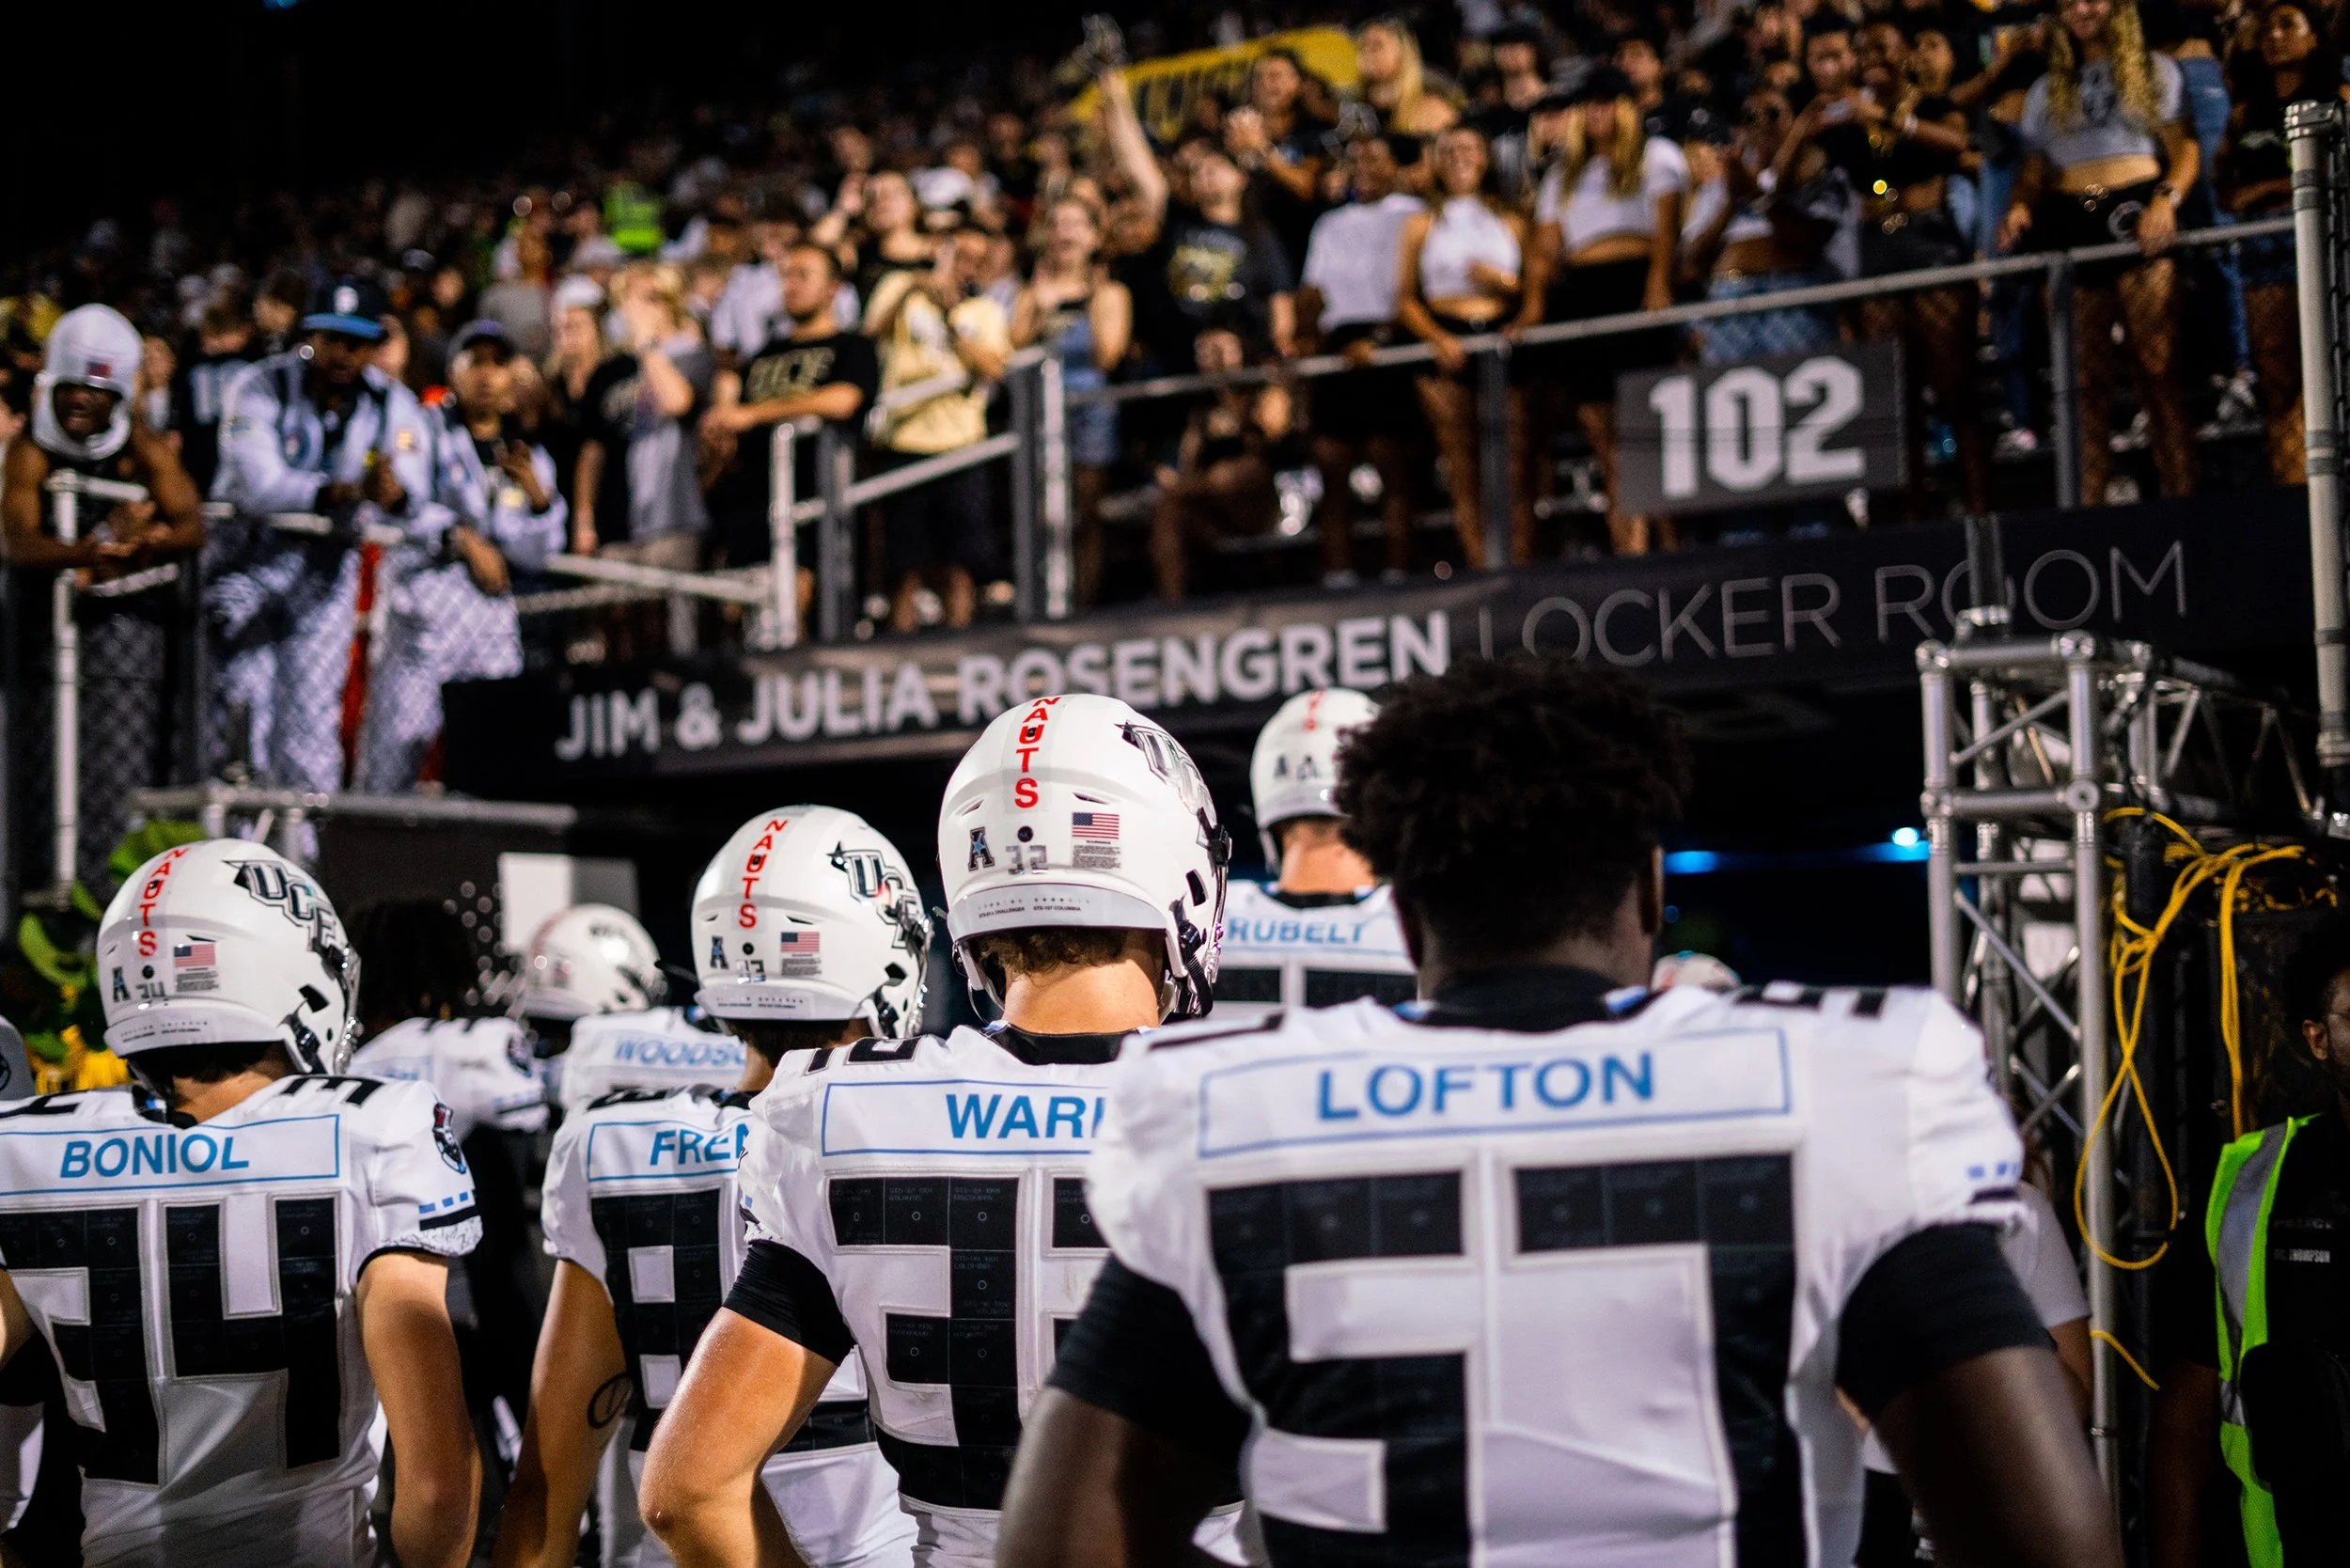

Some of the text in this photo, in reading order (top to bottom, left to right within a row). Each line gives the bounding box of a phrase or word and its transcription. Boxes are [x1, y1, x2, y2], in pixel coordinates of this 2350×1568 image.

[1649, 357, 1866, 499] 102
[556, 687, 660, 760] JIM
[674, 682, 722, 751] &
[737, 661, 937, 745] JULIA
[955, 609, 1451, 725] ROSENGREN
[1014, 697, 1061, 808] NAUTS
[138, 847, 191, 956] NAUTS
[739, 820, 789, 929] NAUTS
[1317, 1051, 1655, 1121] LOFTON
[59, 1132, 249, 1179] BONIOL
[0, 1194, 341, 1485] 34
[1209, 1152, 1806, 1568] 57
